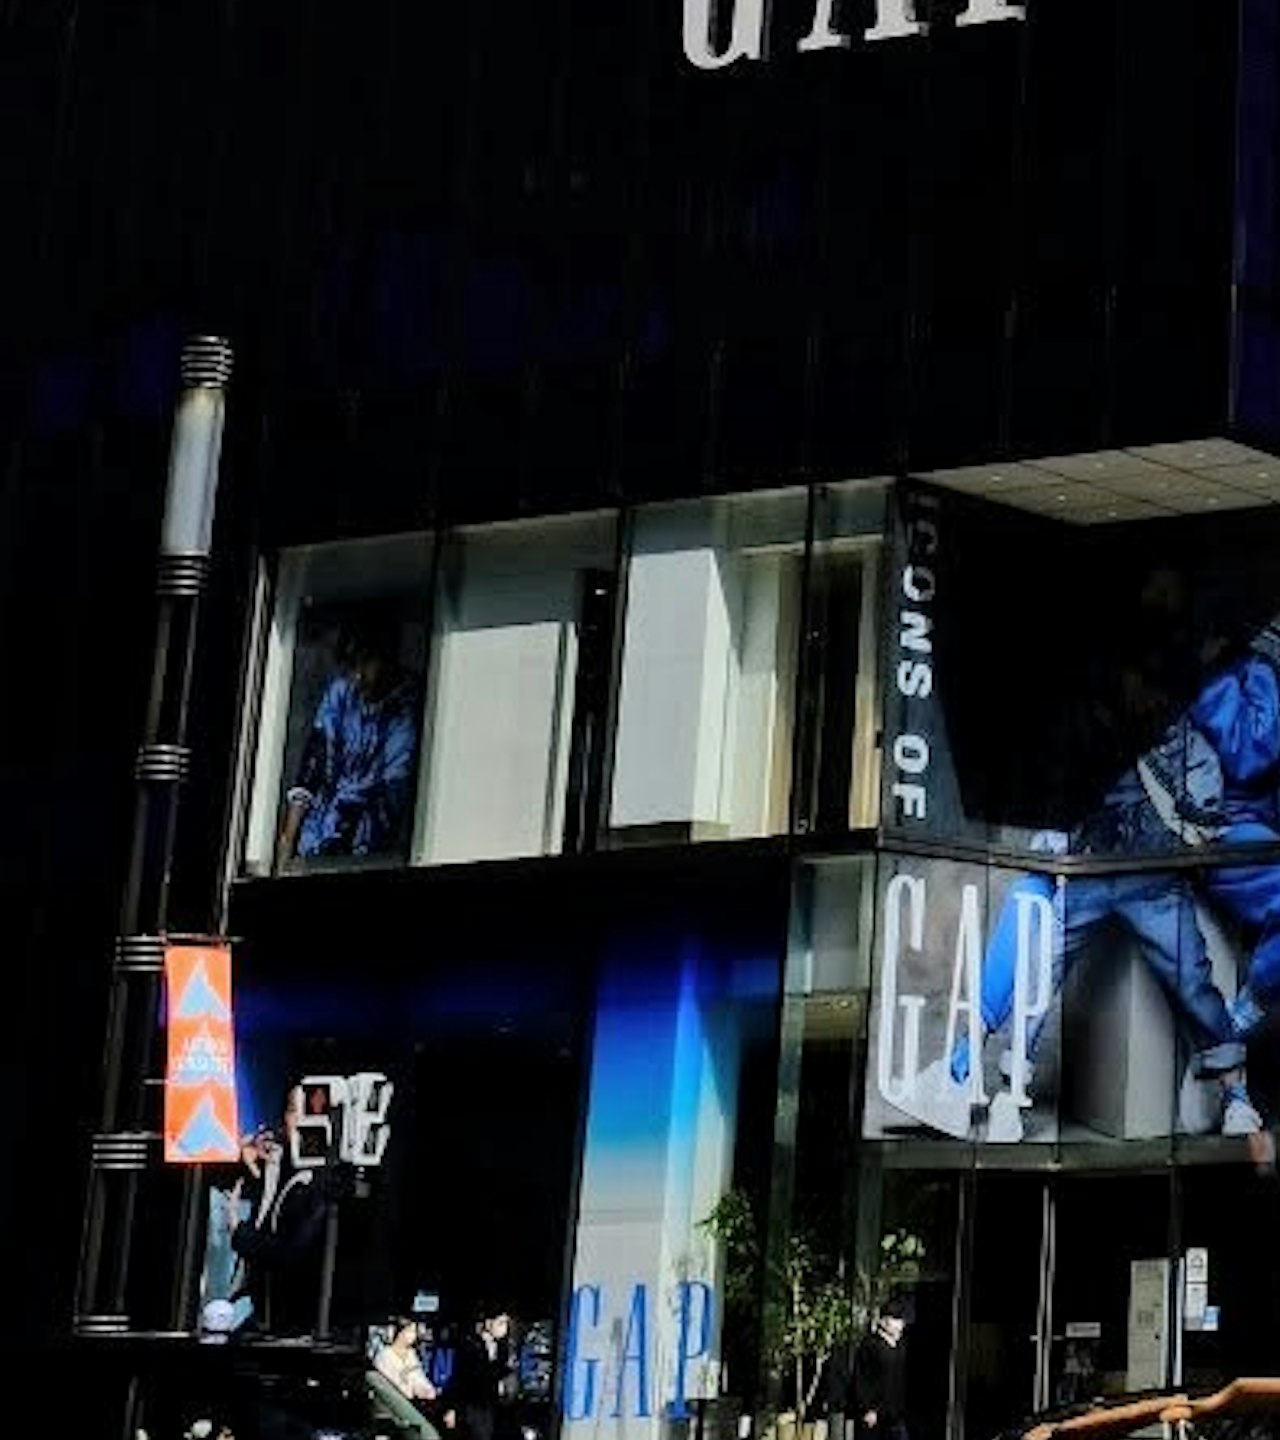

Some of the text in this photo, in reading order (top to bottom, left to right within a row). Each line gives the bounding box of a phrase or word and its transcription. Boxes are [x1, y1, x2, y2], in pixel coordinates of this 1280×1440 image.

[892, 733, 930, 821] OF
[878, 874, 1056, 1114] GAP
[564, 1282, 711, 1421] GAP
